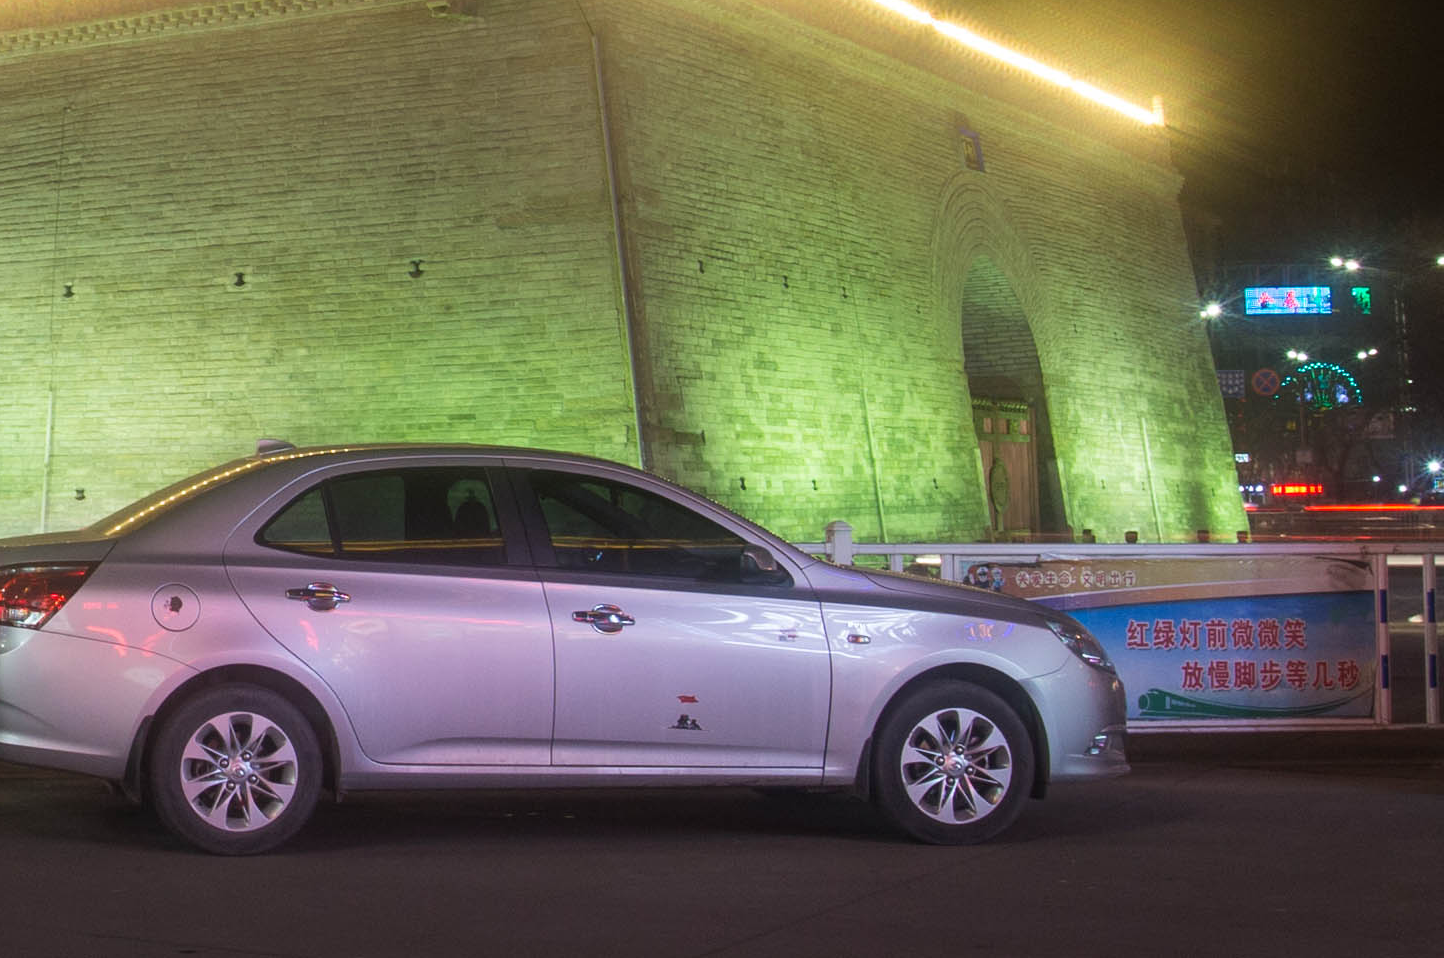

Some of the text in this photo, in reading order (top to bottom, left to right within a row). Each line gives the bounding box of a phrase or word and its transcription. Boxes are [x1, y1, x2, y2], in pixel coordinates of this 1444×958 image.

[1126, 619, 1308, 650] 红绿灯前微微笑
[1181, 660, 1360, 691] 放慢脚步等几秒
